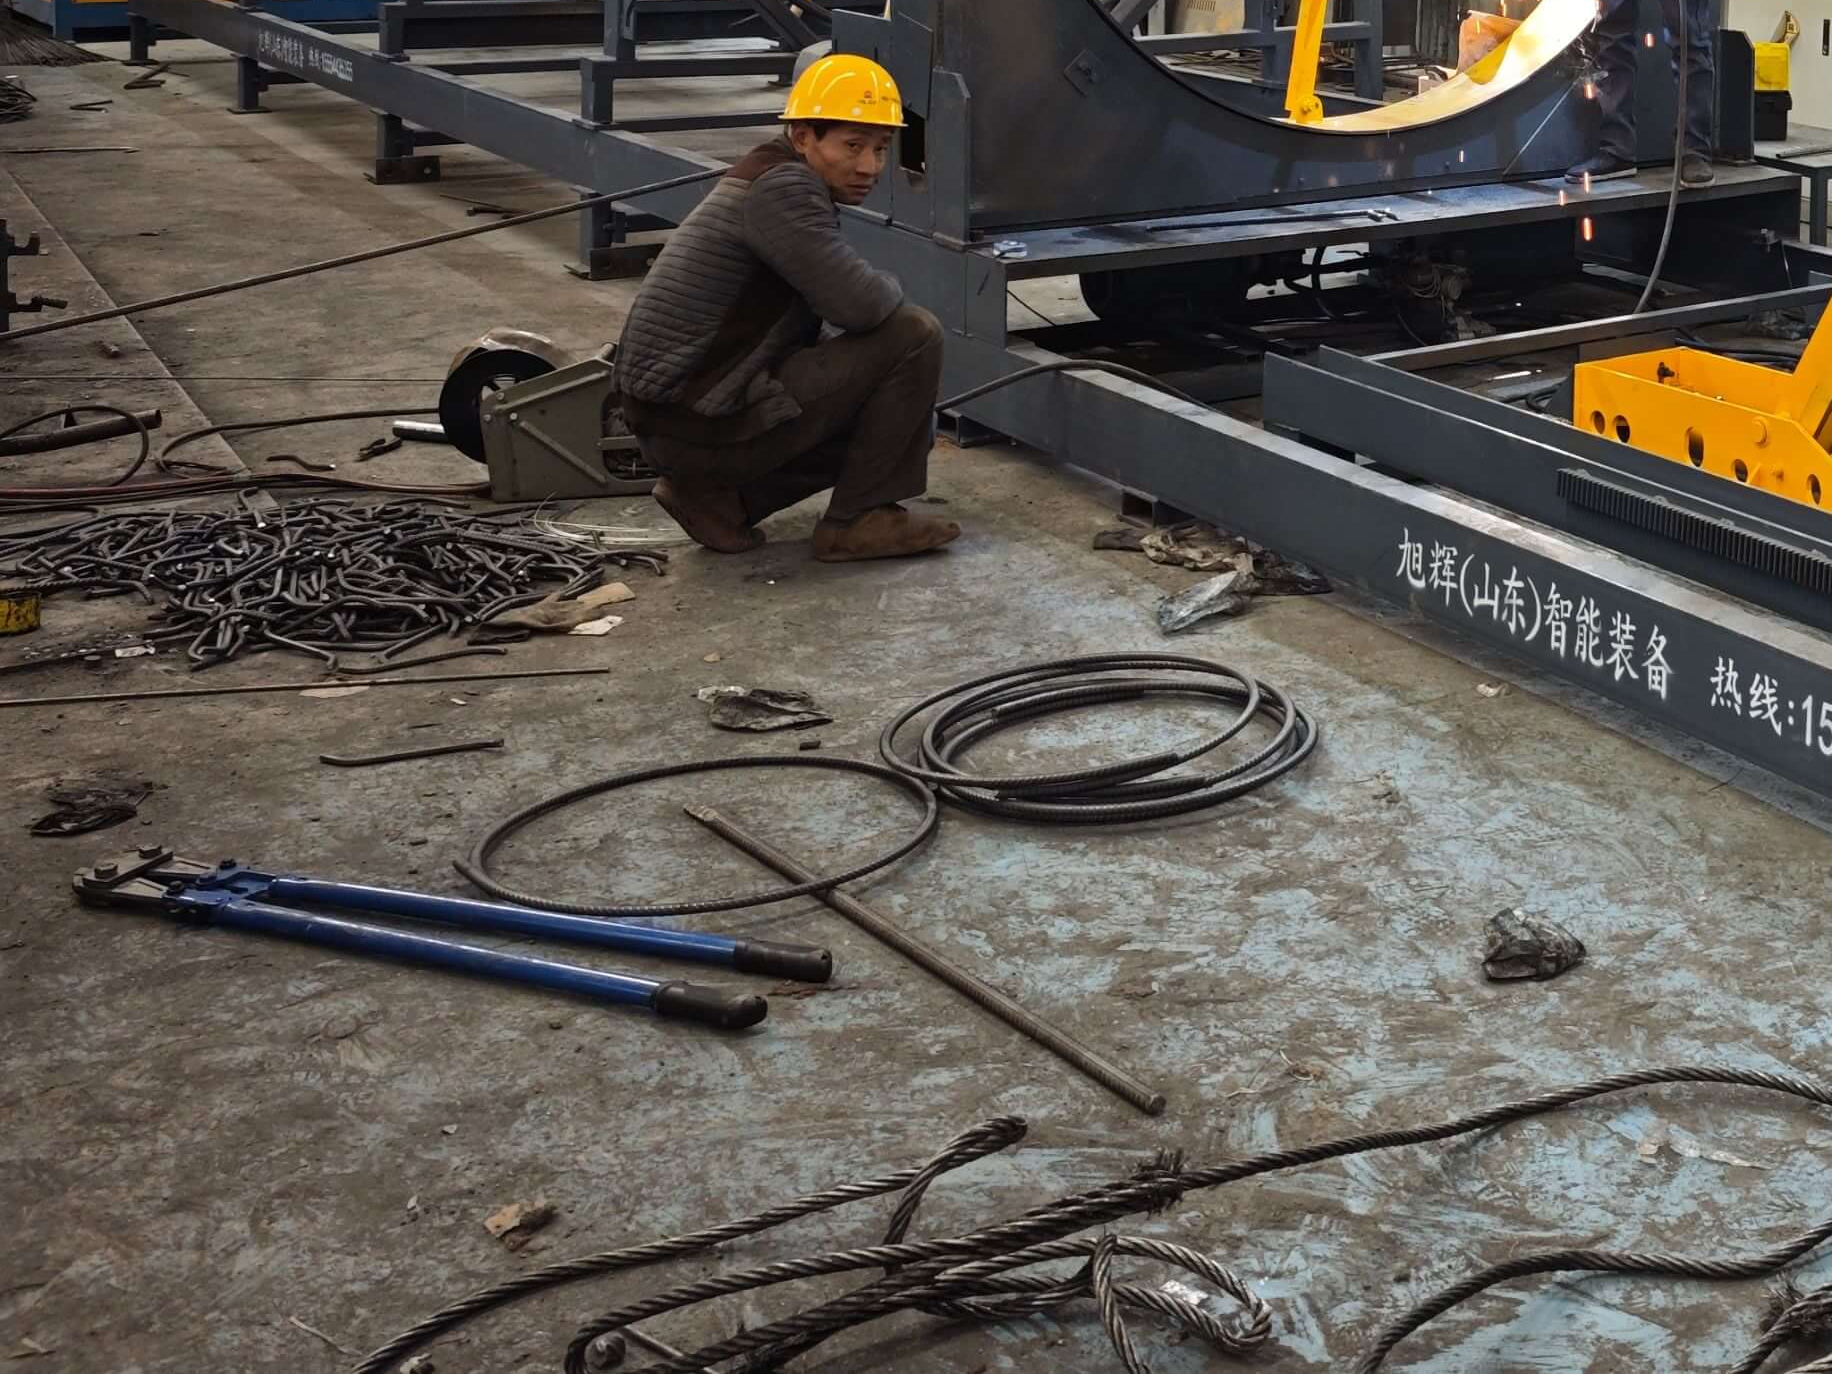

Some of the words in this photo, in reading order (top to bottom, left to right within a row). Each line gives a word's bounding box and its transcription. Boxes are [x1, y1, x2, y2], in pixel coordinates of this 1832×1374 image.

[1396, 527, 1675, 703] 旭辉(山东)智能装备
